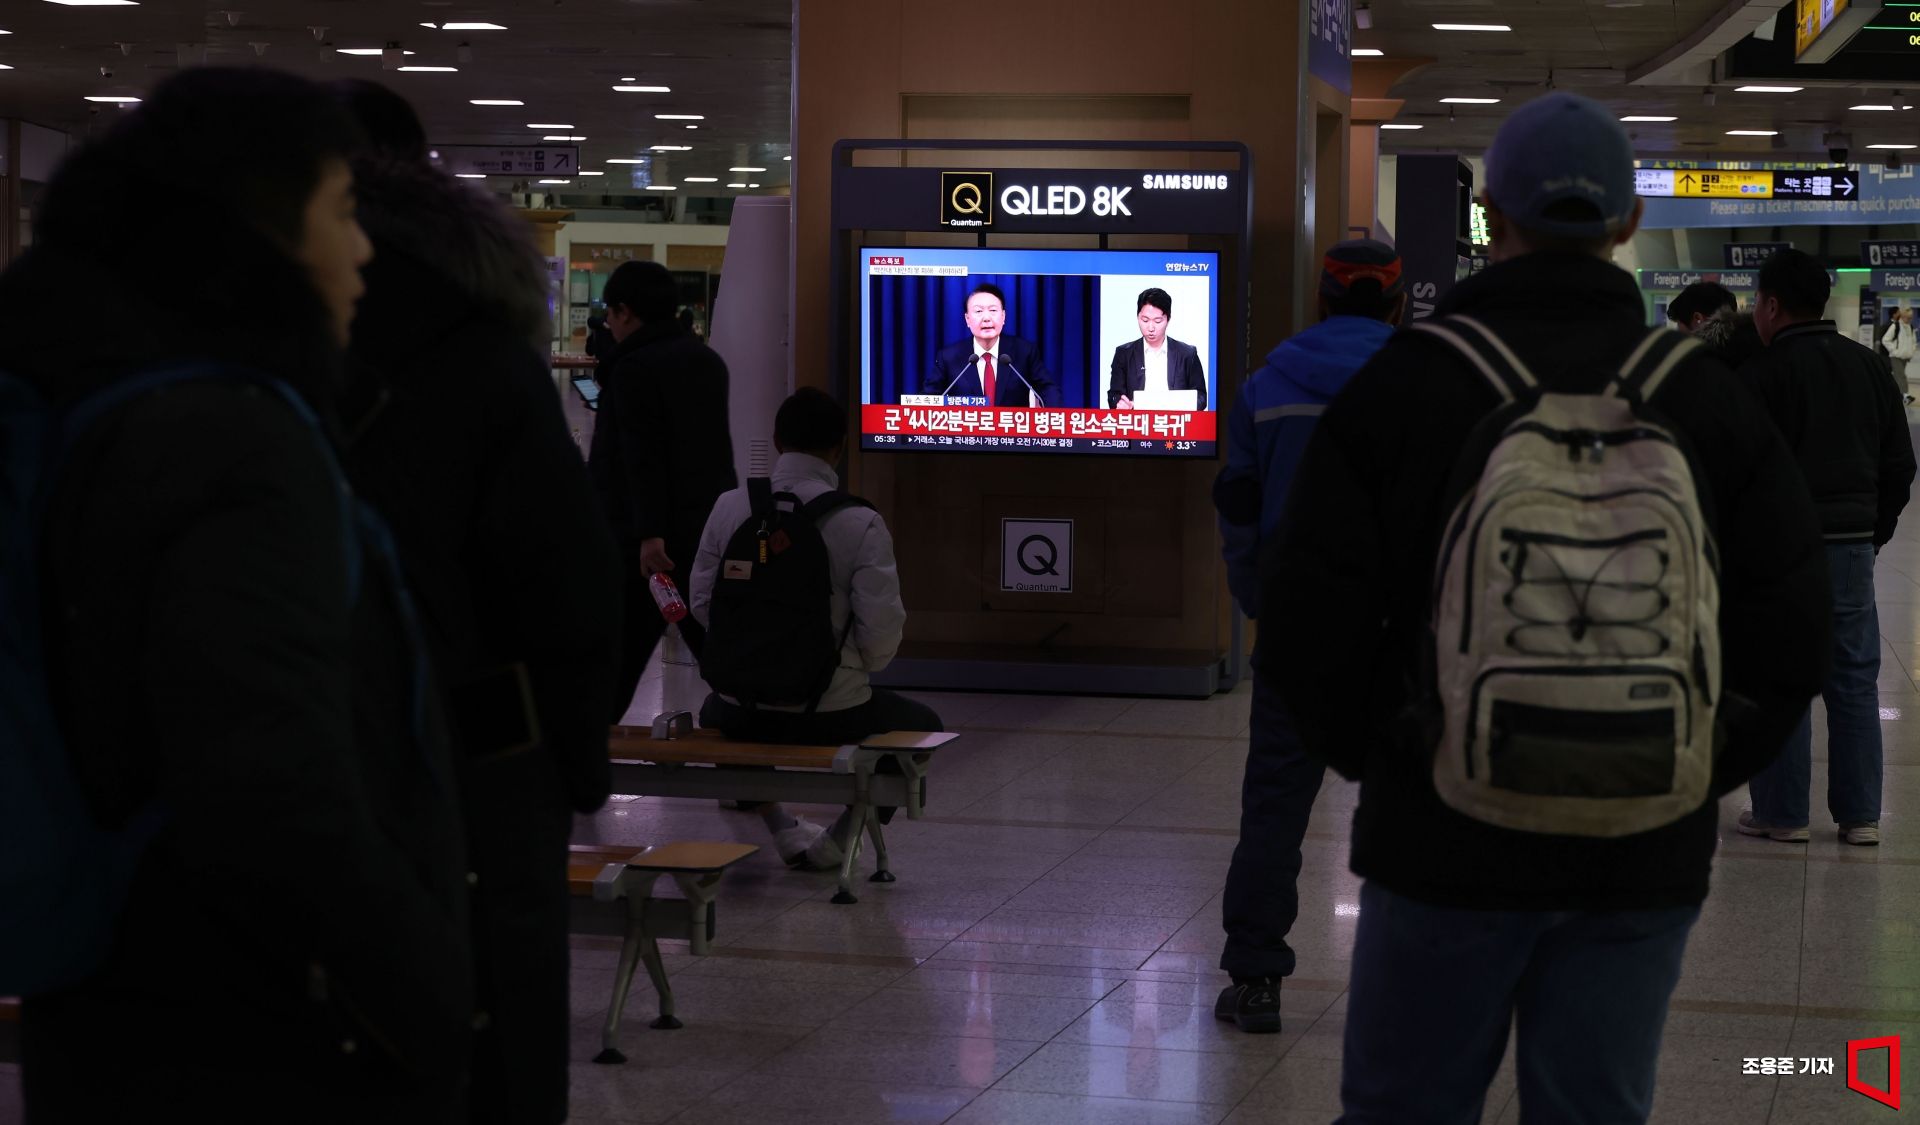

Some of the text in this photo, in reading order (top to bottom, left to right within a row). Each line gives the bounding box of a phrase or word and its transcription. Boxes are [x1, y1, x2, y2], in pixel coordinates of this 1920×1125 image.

[1143, 174, 1227, 190] SAMSUNG
[951, 182, 984, 214] Q
[1001, 185, 1132, 216] QLED 8K
[1710, 201, 1738, 215] Please
[1740, 203, 1755, 214] use
[1766, 201, 1791, 213] ticket
[1794, 200, 1833, 212] machine
[1834, 199, 1848, 212] for
[1859, 199, 1885, 214] quick
[950, 219, 983, 227] Quantum
[1165, 263, 1209, 272] 연합뉴스TV
[1653, 272, 1680, 288] Foreign
[1719, 272, 1753, 287] Available
[1884, 272, 1915, 290] Foreign
[970, 397, 986, 406] 기자
[884, 408, 1191, 437] 군 "4시22분부로 투입 병력 원소속부대 복귀"
[874, 435, 896, 443] 05:35
[913, 435, 1073, 448] 거래소, 오늘 국내증시 개장 여부 오전 7시30분 결정
[1097, 440, 1129, 448] 코스피200
[1017, 534, 1059, 576] Q
[1016, 582, 1058, 592] Quantum
